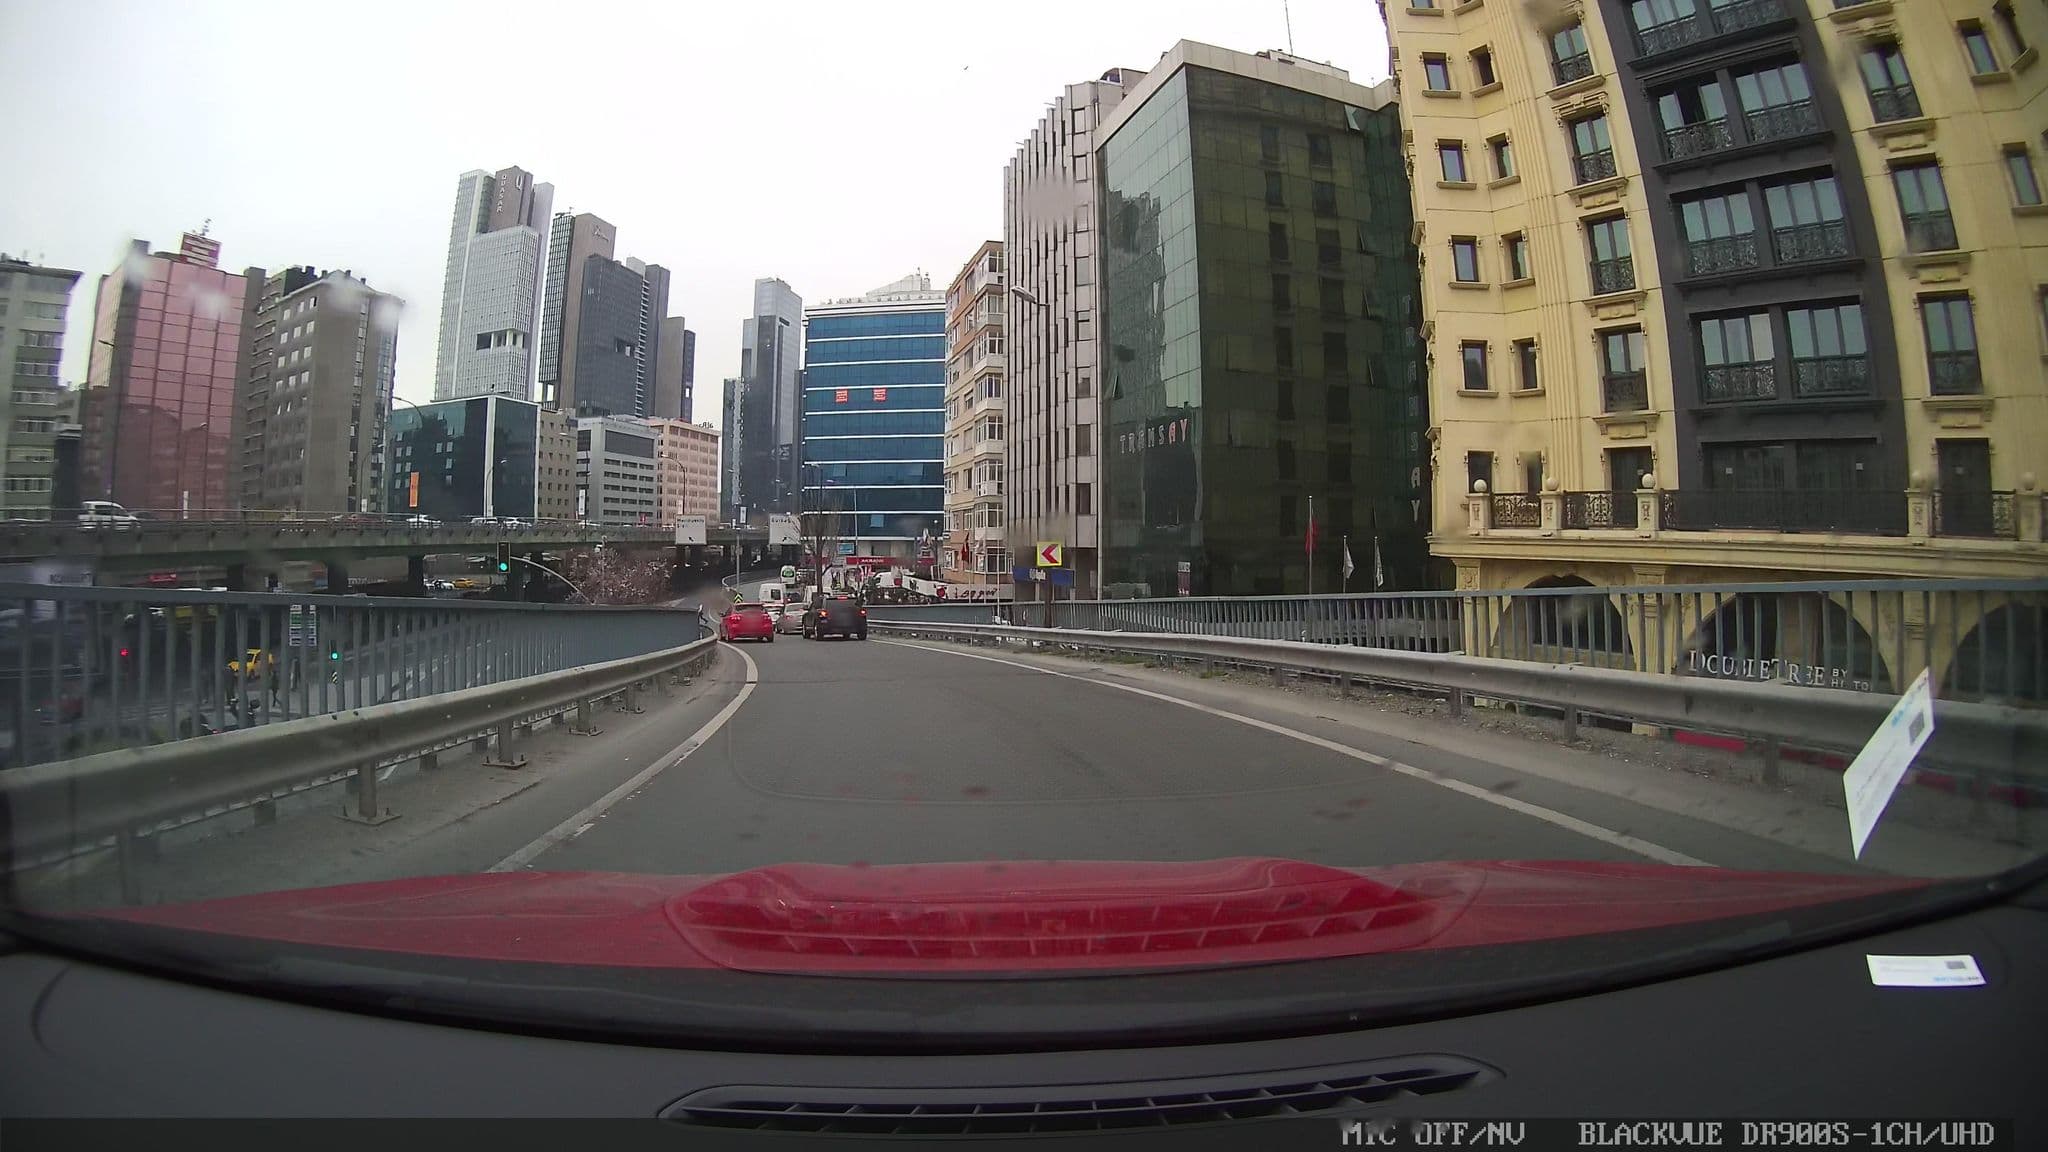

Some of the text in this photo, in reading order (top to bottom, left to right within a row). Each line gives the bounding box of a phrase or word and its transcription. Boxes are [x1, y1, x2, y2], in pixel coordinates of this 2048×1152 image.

[496, 174, 507, 215] QUASAR
[1119, 418, 1188, 455] TRANSAY
[1831, 678, 1873, 692] HITO
[1832, 668, 1848, 678] BY
